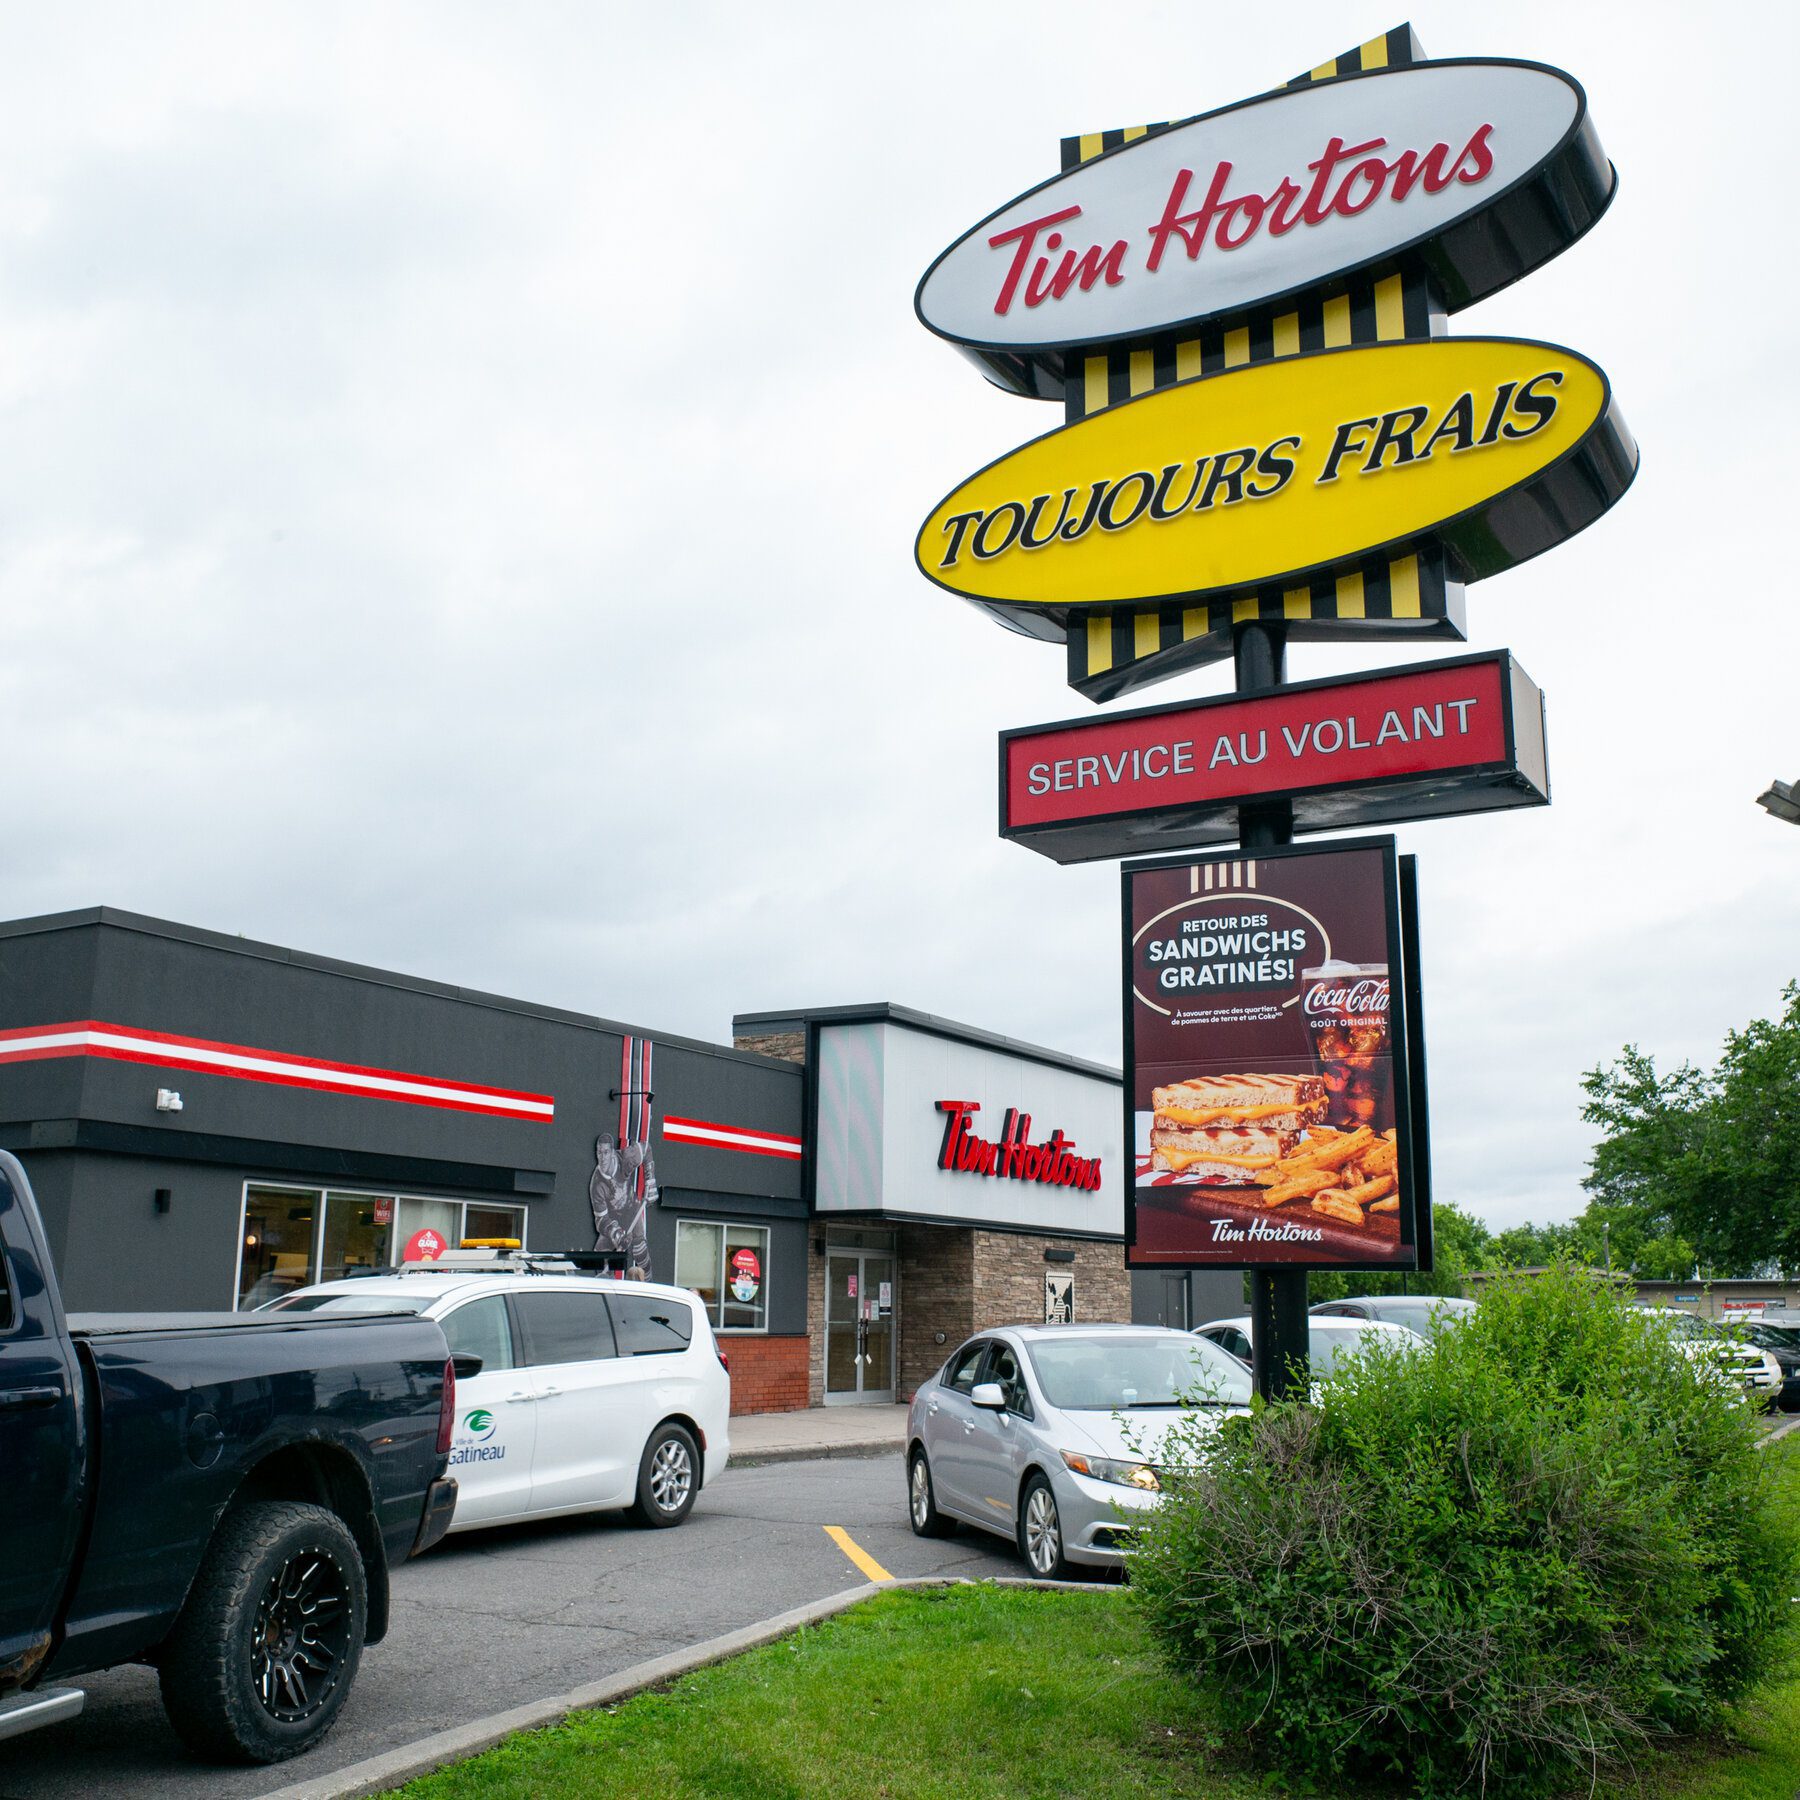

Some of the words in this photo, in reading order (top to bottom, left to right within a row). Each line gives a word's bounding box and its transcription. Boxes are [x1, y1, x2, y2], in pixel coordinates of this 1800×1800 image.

[988, 204, 1129, 316] Tim
[1146, 123, 1495, 273] Hortons
[939, 436, 1301, 568] TOUJOURS
[1316, 371, 1564, 484] FRAIS
[1027, 741, 1195, 796] SERVICE
[1209, 730, 1268, 769] AU
[1282, 698, 1478, 758] VOLANT
[1183, 917, 1238, 933] RETOUR
[1241, 914, 1269, 928] DES
[1149, 929, 1307, 962] SANDWICHS
[1160, 953, 1295, 989] GRATINÉS!
[1176, 1009, 1182, 1018] À
[1182, 1010, 1212, 1018] savourer
[1244, 1005, 1278, 1014] quartiers
[1303, 979, 1390, 1015] Coca-Cola
[1181, 1017, 1210, 1026] pommes
[1210, 1015, 1220, 1023] de
[1239, 1013, 1247, 1021] et
[1310, 1018, 1337, 1028] GOÛT
[1340, 1017, 1388, 1026] ORIGINAL
[934, 1100, 997, 1177] Tim
[996, 1107, 1102, 1191] Hortons
[1210, 1219, 1244, 1242] Tim
[1248, 1218, 1323, 1242] Hortons
[448, 1445, 506, 1466] Gatineau
